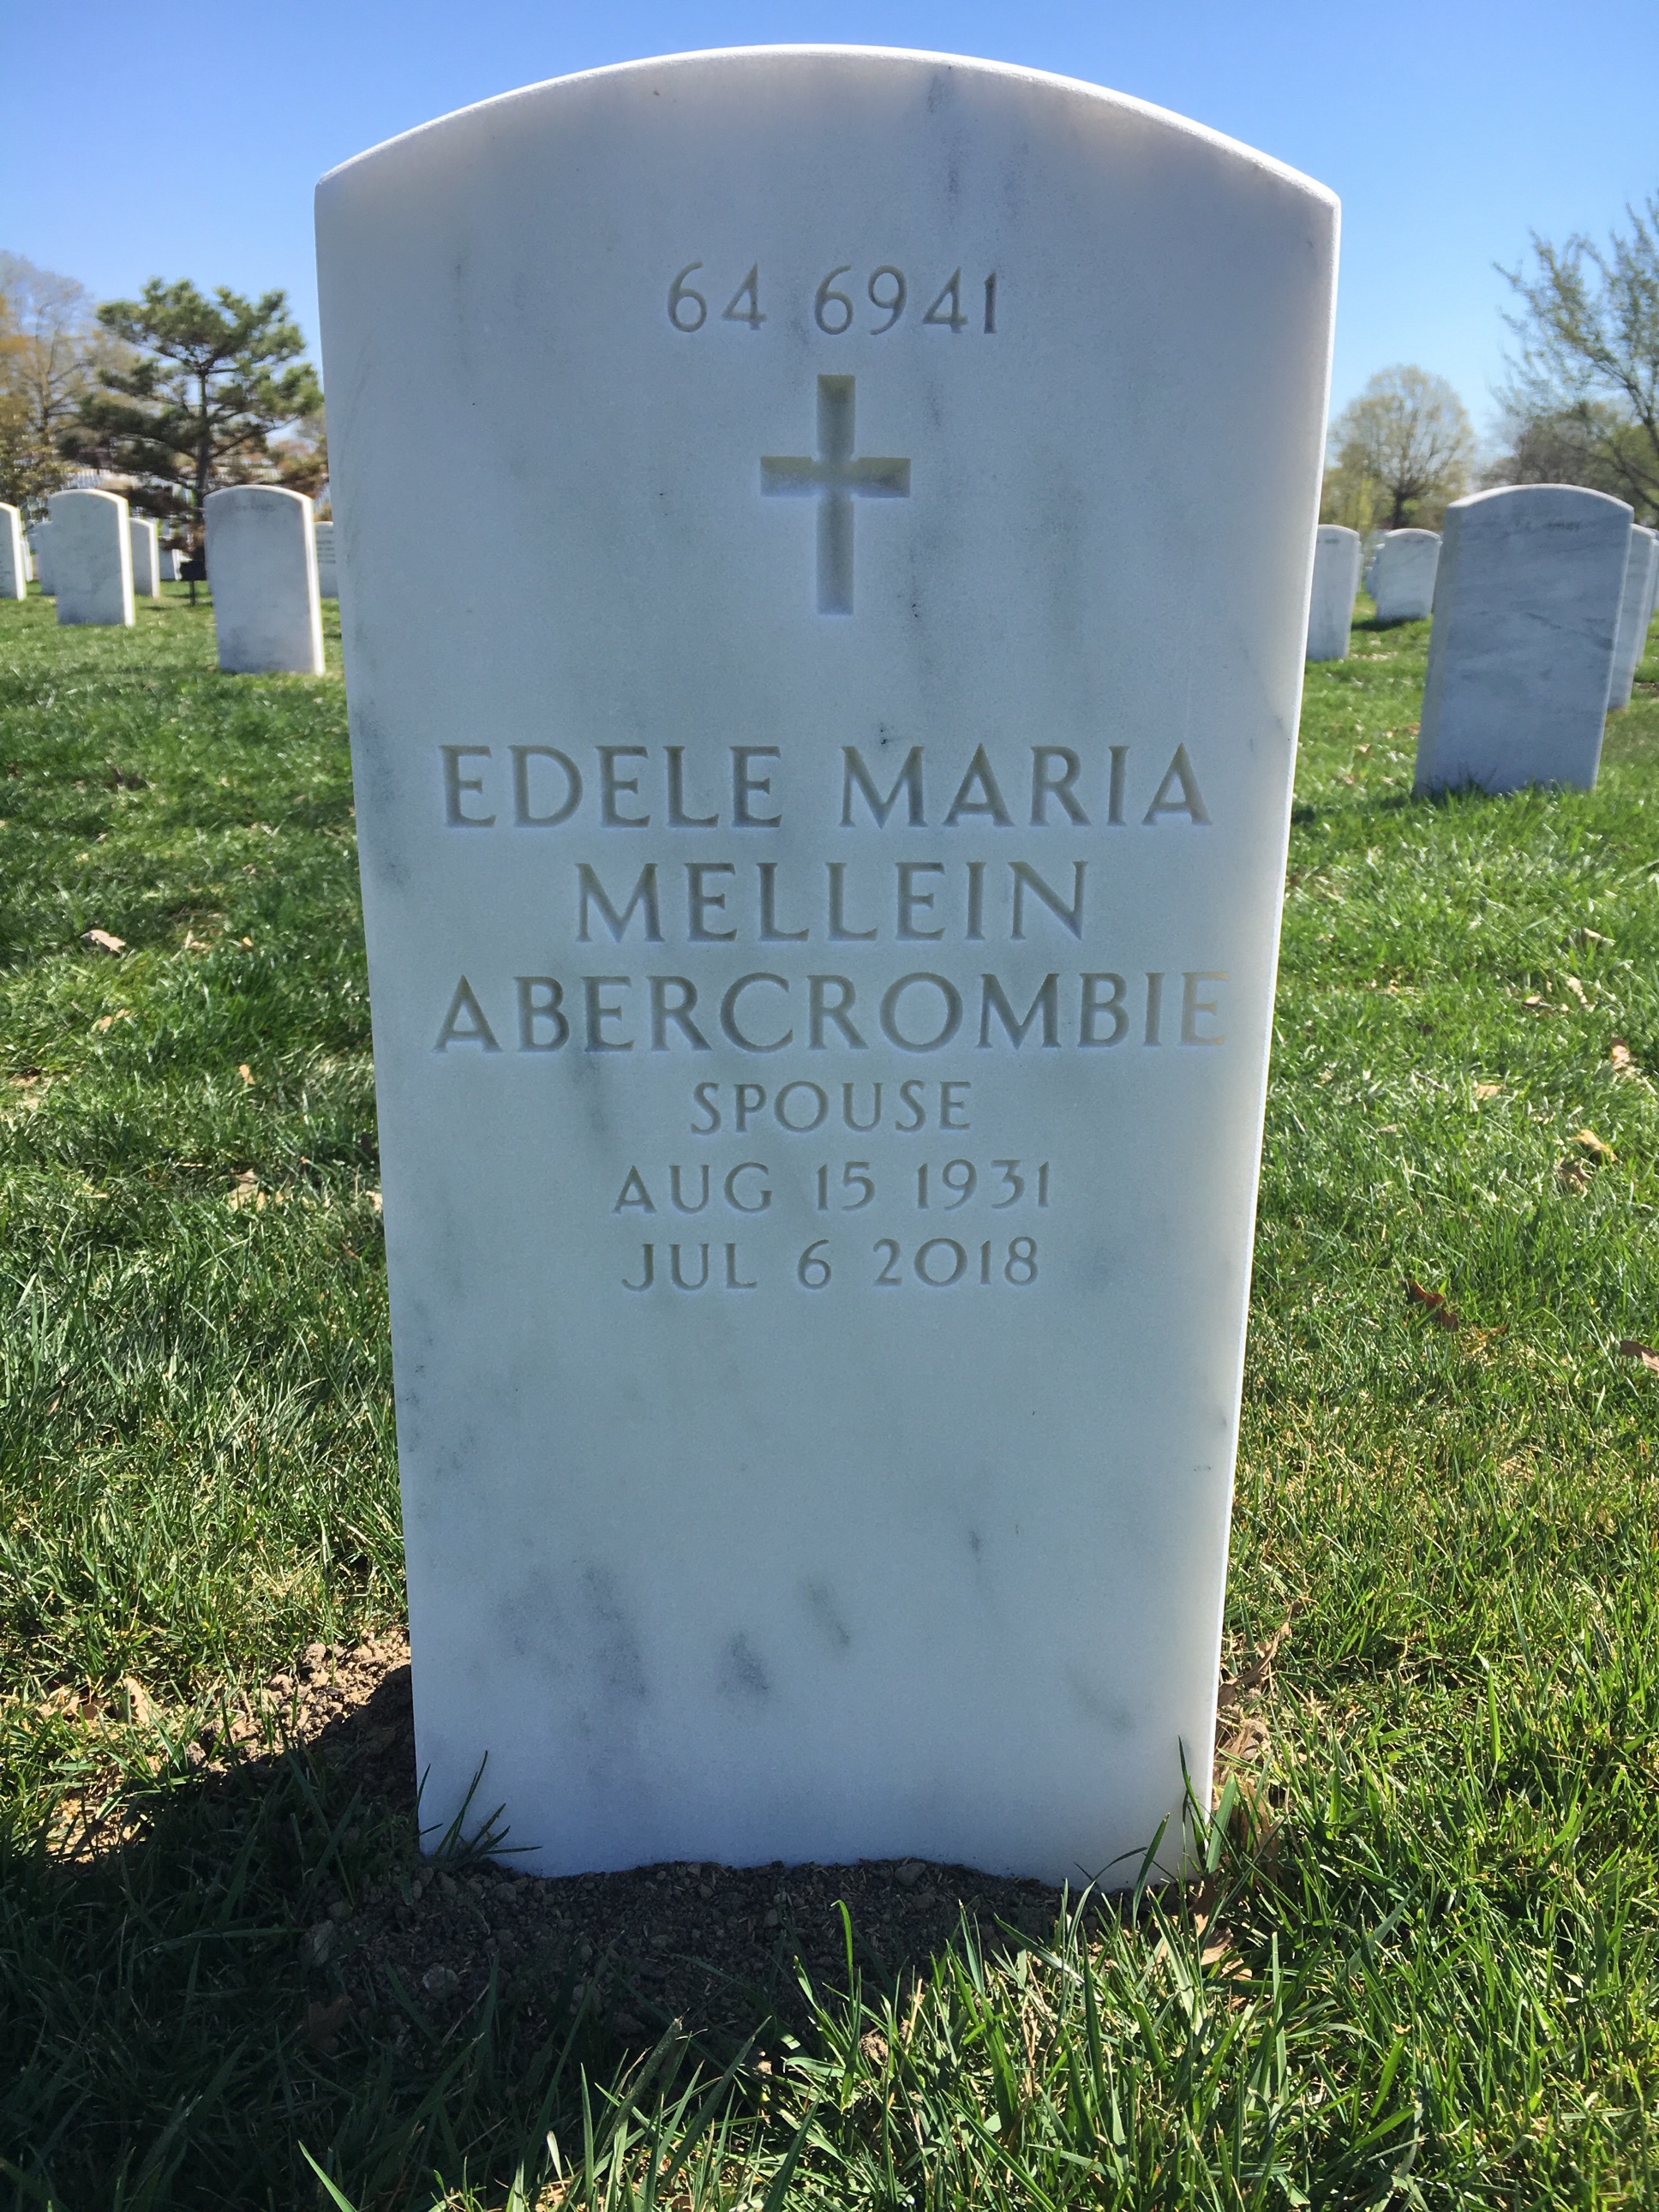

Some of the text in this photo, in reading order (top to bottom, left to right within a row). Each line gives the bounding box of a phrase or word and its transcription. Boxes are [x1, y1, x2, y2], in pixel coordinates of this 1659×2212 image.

[668, 261, 997, 335] 64 6941
[438, 742, 1213, 830] EDELE MARIA
[574, 860, 1088, 943] MELLEIN
[429, 971, 1229, 1053] ABERCROMBIE
[691, 1080, 971, 1135] SPOUSE
[612, 1158, 1050, 1214] AUG 15 1931
[621, 1236, 1039, 1292] JUL 6 2018
